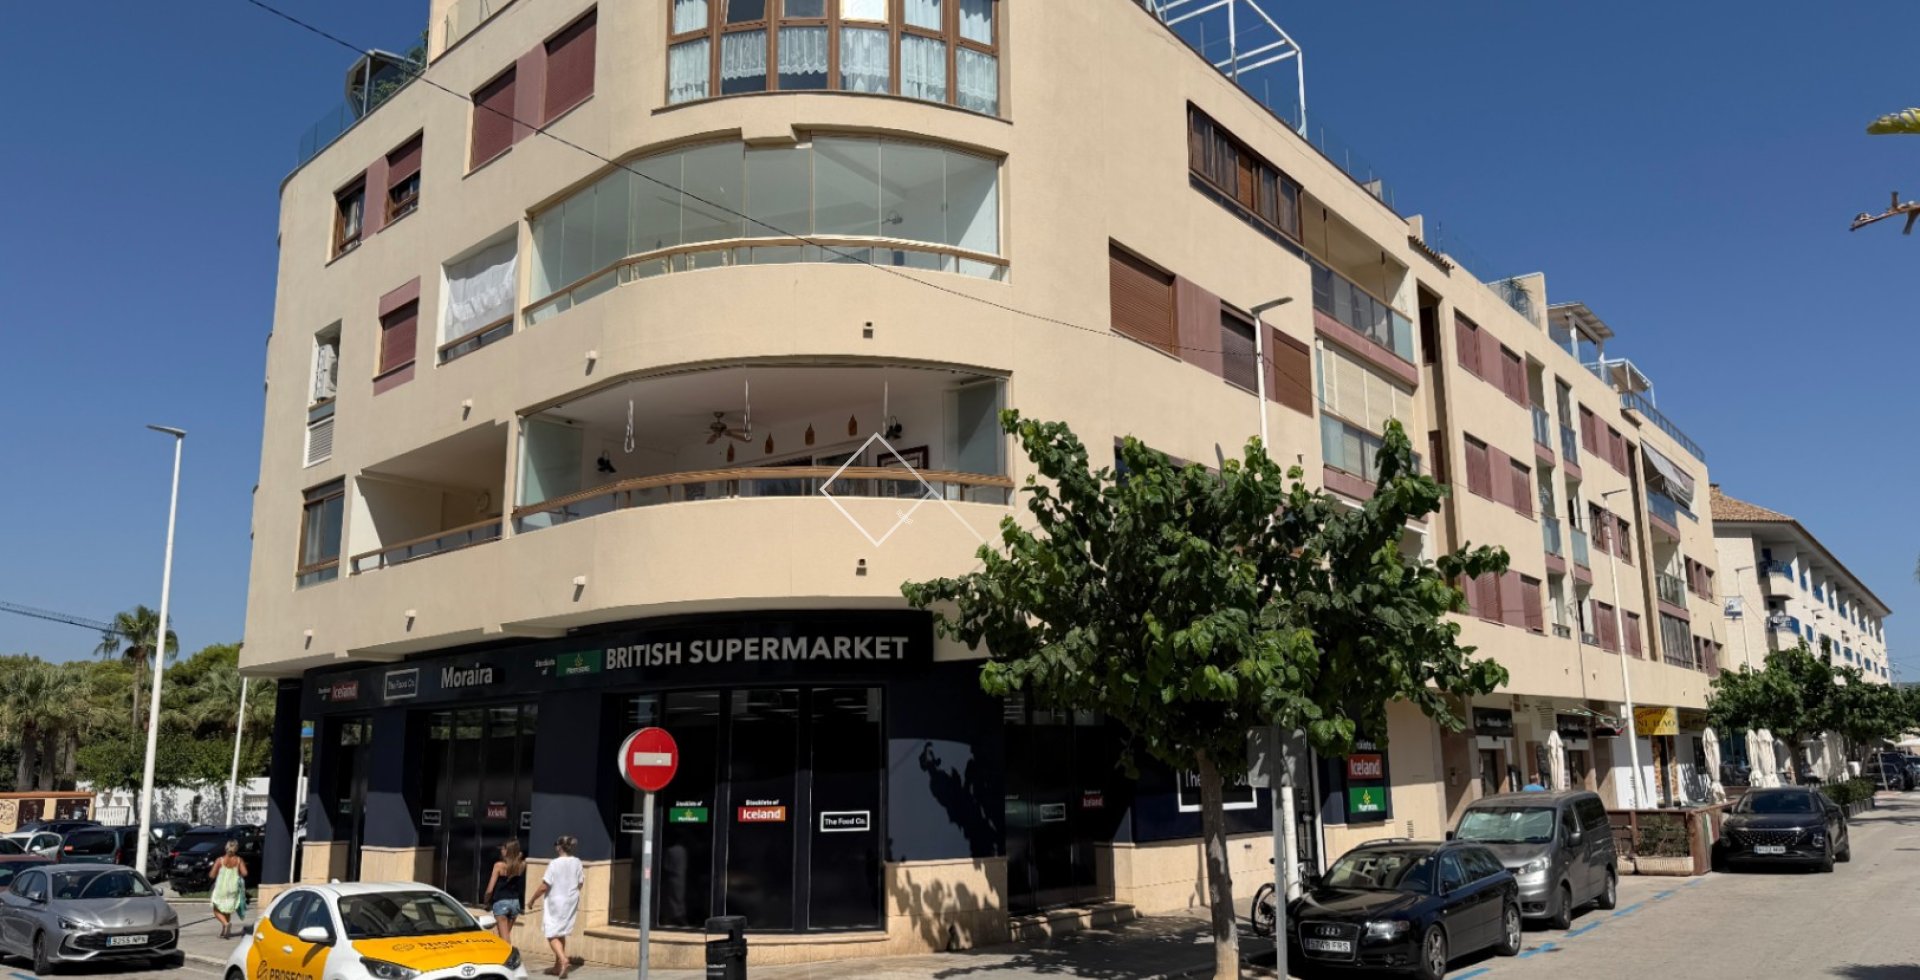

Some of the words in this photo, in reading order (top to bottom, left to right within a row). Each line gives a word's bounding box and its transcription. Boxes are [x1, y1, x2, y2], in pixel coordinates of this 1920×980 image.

[606, 642, 682, 670] BRITISH
[689, 636, 909, 664] SUPERMARKET
[441, 662, 493, 689] Moraira
[332, 682, 357, 699] Iceland
[1350, 758, 1382, 775] Iceland
[743, 808, 781, 819] Iceland
[824, 818, 837, 826] The
[838, 817, 855, 825] Food
